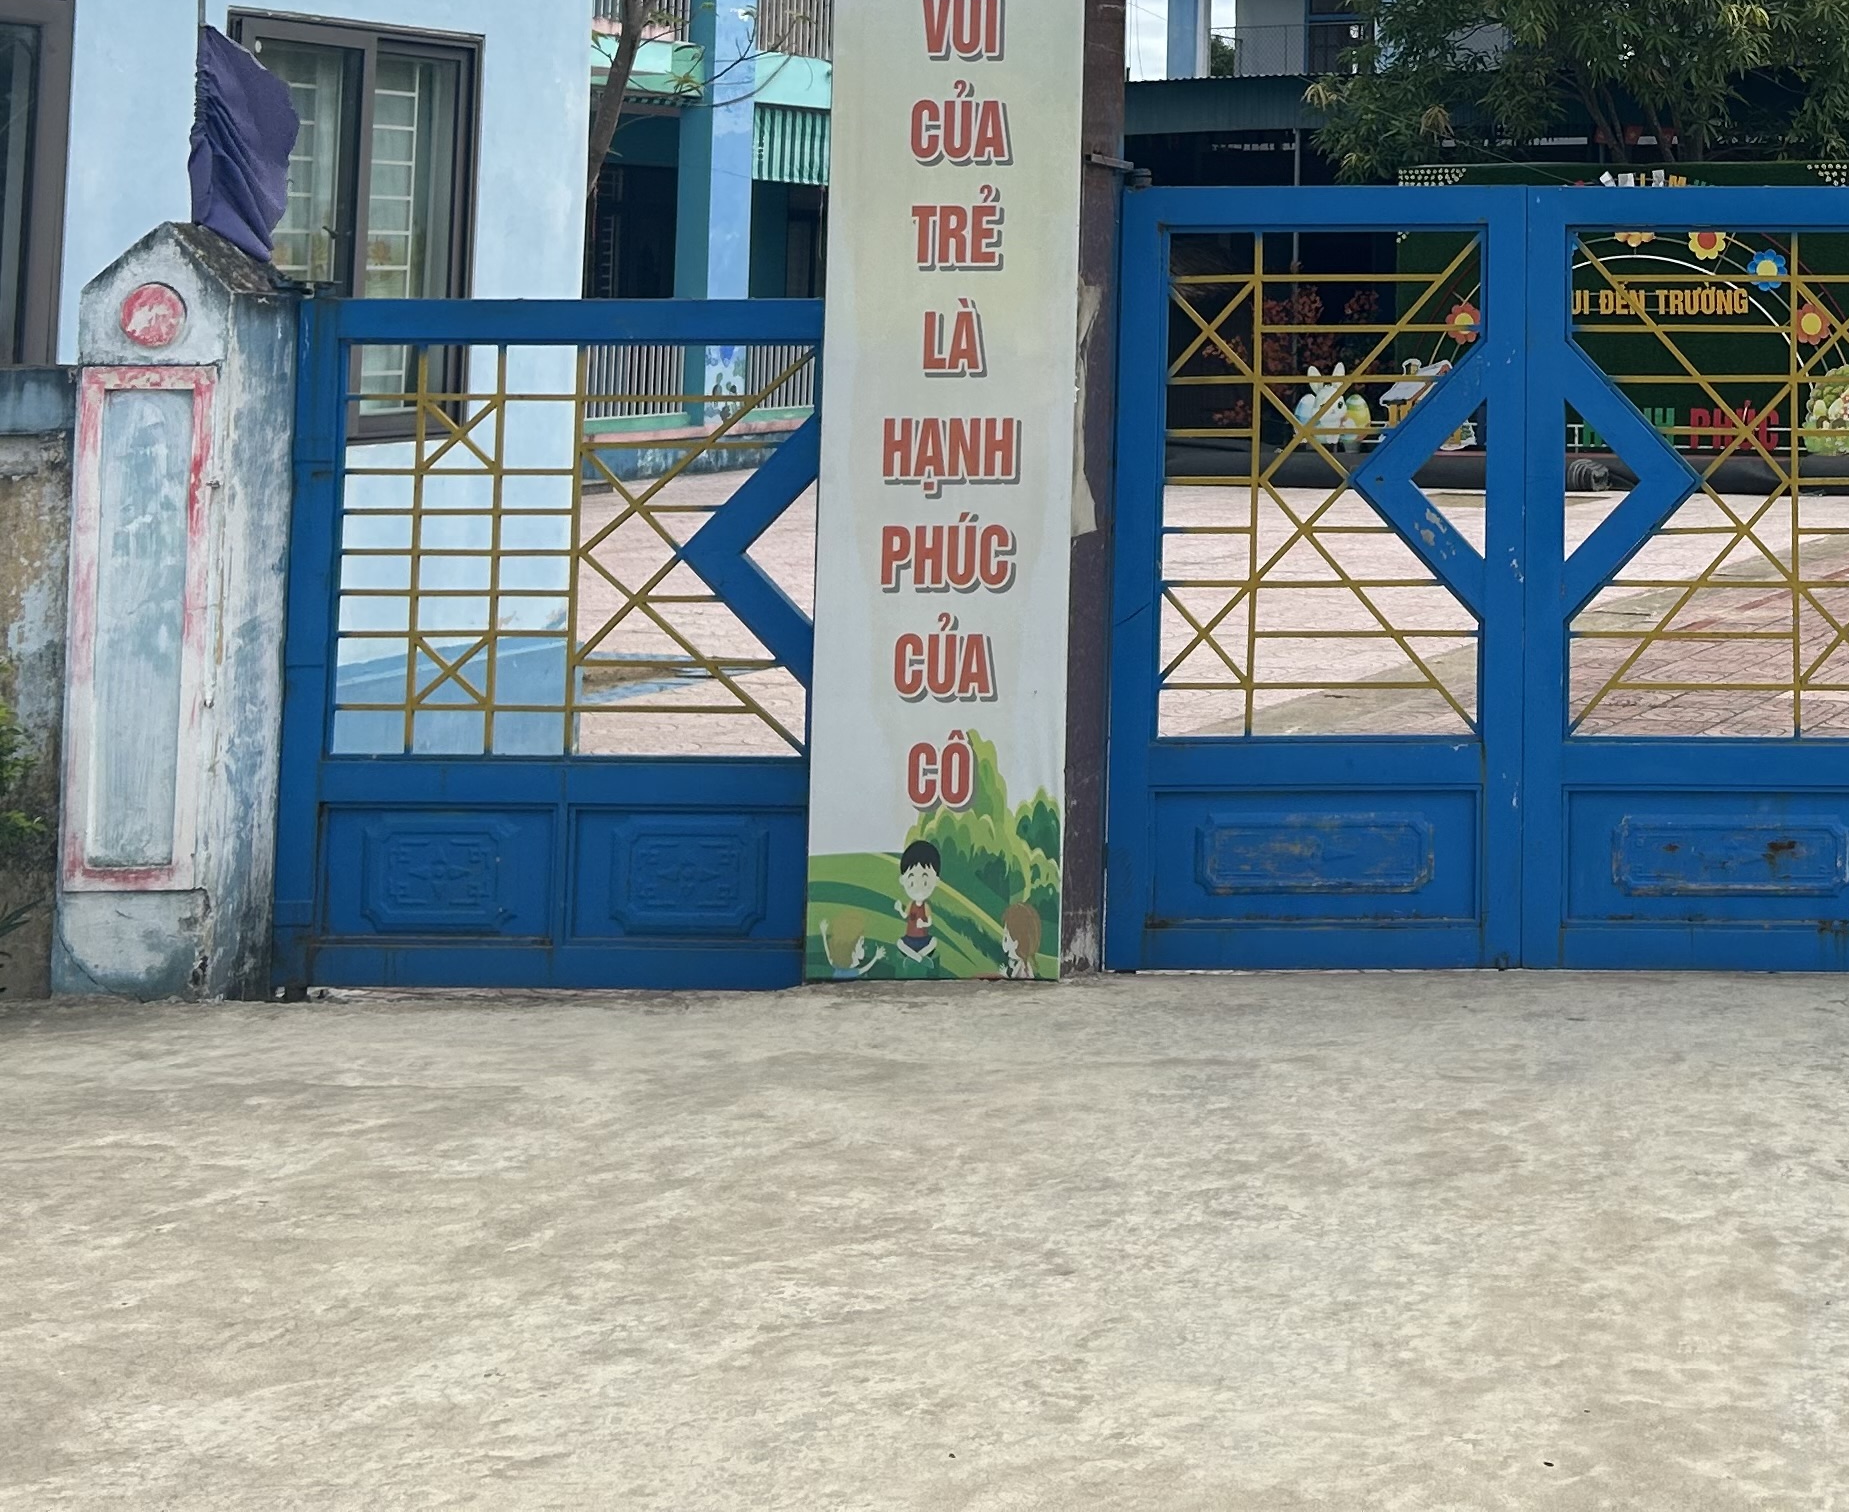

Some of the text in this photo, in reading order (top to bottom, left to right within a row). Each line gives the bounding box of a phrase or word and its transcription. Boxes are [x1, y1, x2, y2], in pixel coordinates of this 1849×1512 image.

[911, 80, 1006, 159] CỦA
[912, 185, 998, 264] TRẺ
[923, 299, 980, 370] LÀ
[1656, 281, 1748, 315] TRƯỜNG
[883, 418, 1014, 491] HẠNH
[881, 513, 1009, 585] PHÚC
[894, 613, 990, 694] CỦA
[908, 730, 972, 804] CÔ
